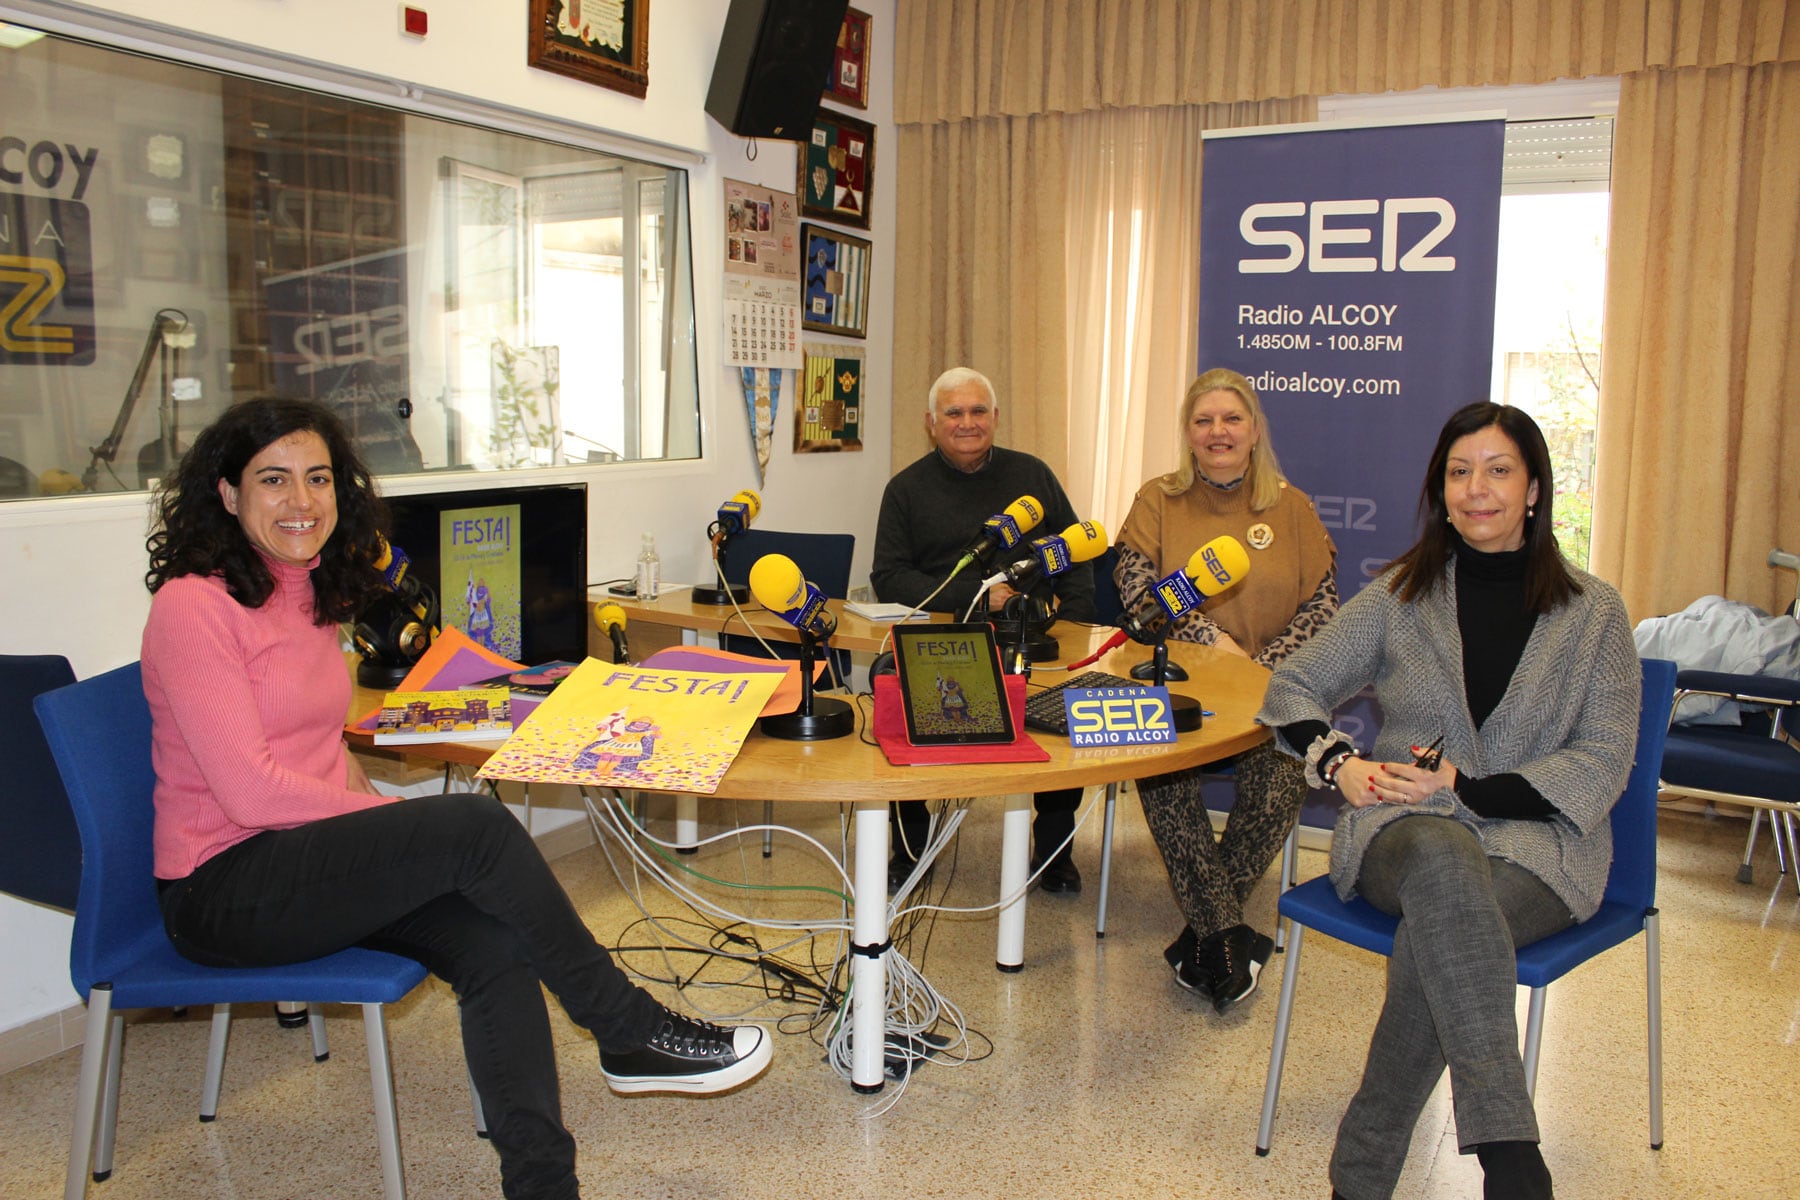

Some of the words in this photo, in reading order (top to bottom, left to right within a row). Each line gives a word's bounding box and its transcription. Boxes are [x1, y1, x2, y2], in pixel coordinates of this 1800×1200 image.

[1238, 197, 1456, 273] SER
[1238, 305, 1303, 325] Radio
[1310, 304, 1397, 326] ALCOY
[1328, 336, 1403, 351] 100.8FM
[1245, 371, 1401, 398] adioalcoy.com
[453, 516, 510, 552] FESTA!
[1201, 547, 1231, 586] SER
[1160, 585, 1183, 615] SER
[916, 641, 978, 662] FESTA!
[602, 671, 750, 703] FESTA!
[1086, 688, 1147, 698] CADENA
[1070, 697, 1169, 733] SER
[1075, 732, 1120, 745] RADIO
[1126, 730, 1170, 742] ALCOY
